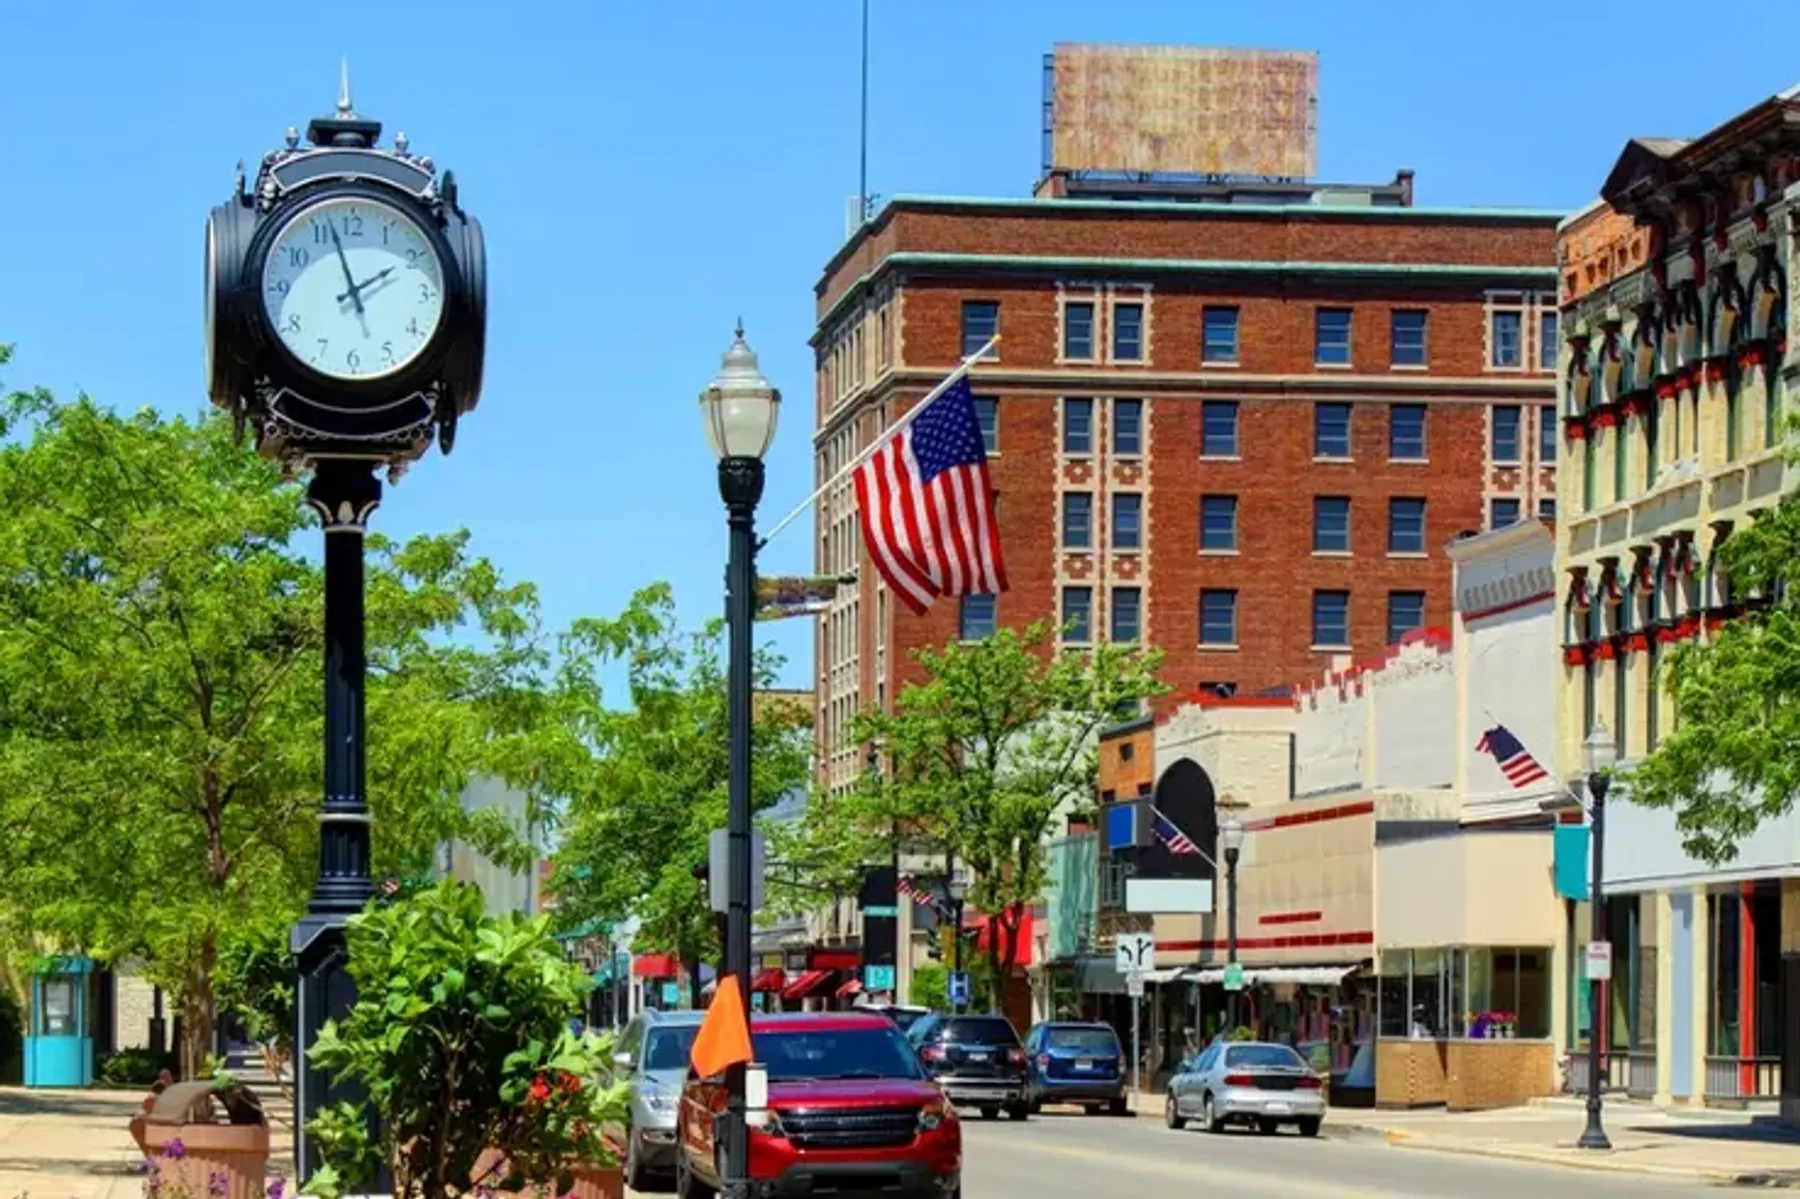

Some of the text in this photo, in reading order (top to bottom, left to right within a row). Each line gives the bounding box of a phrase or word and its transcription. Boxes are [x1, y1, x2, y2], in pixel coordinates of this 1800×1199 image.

[313, 224, 328, 244] 11
[342, 216, 363, 236] 12
[382, 225, 388, 245] 1
[289, 247, 309, 267] 10
[405, 249, 419, 269] 2
[277, 279, 290, 295] 9
[418, 284, 429, 304] 3
[288, 315, 301, 334] 8
[406, 317, 417, 336] 4
[317, 338, 328, 357] 7
[381, 342, 392, 361] 5
[347, 349, 360, 368] 6
[951, 974, 969, 997] H
